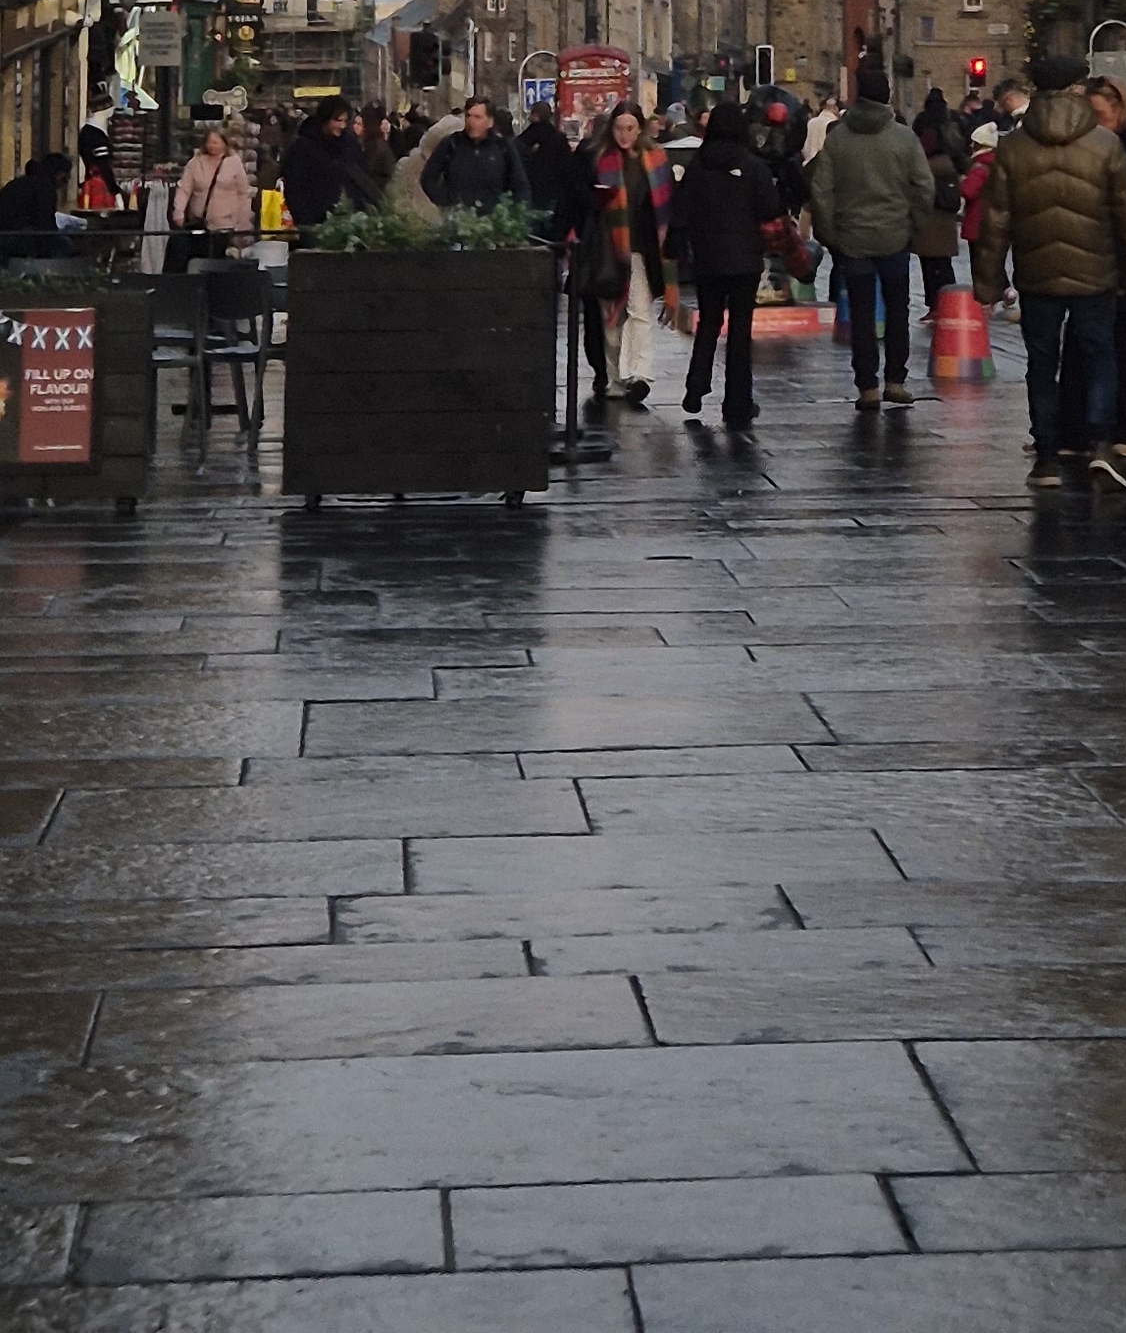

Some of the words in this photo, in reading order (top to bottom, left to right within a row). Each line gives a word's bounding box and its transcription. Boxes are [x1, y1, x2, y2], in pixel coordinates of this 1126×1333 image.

[53, 369, 72, 380] UP
[73, 368, 95, 380] ON
[29, 383, 89, 395] FLAVOUR
